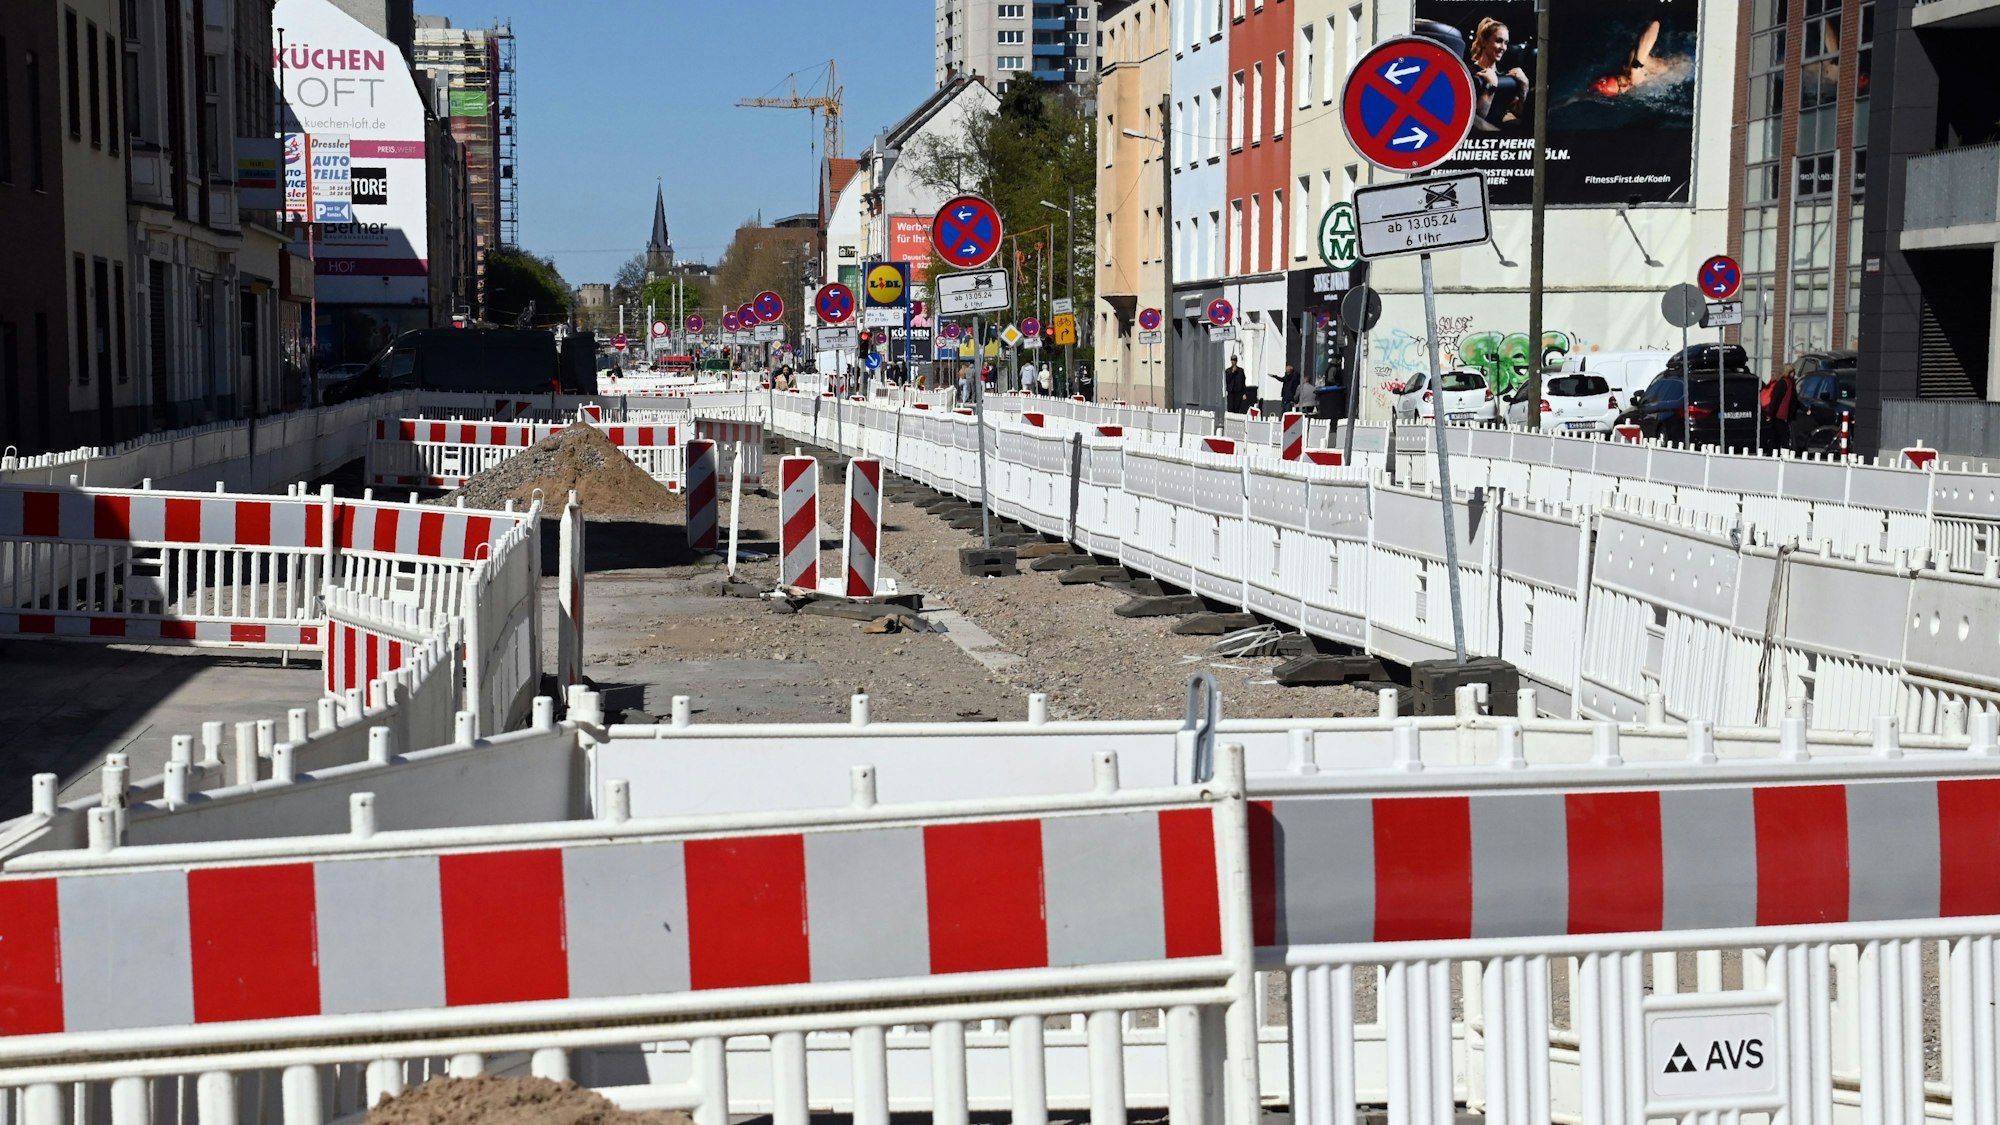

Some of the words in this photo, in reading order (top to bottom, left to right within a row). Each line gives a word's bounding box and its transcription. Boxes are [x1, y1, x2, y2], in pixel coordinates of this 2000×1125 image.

[273, 43, 385, 71] KÜCHEN
[275, 77, 384, 107] OFT
[311, 139, 350, 149] Dressler
[1459, 138, 1498, 150] ILLST
[1500, 150, 1516, 160] 6x
[1517, 150, 1532, 160] IN
[312, 156, 350, 167] AUTO
[313, 169, 349, 180] TEILE
[1584, 174, 1671, 184] FitnessFirst.de/Koeln
[351, 178, 387, 196] TORE
[1387, 222, 1402, 233] ab
[1408, 213, 1457, 230] 13.05.24
[897, 234, 911, 243] für
[912, 234, 926, 243] Ihr
[1406, 236, 1413, 246] 6
[1418, 232, 1442, 243] Uhr
[328, 260, 357, 273] HOF
[966, 292, 992, 300] 13.05.24
[1705, 1038, 1764, 1071] AVS
